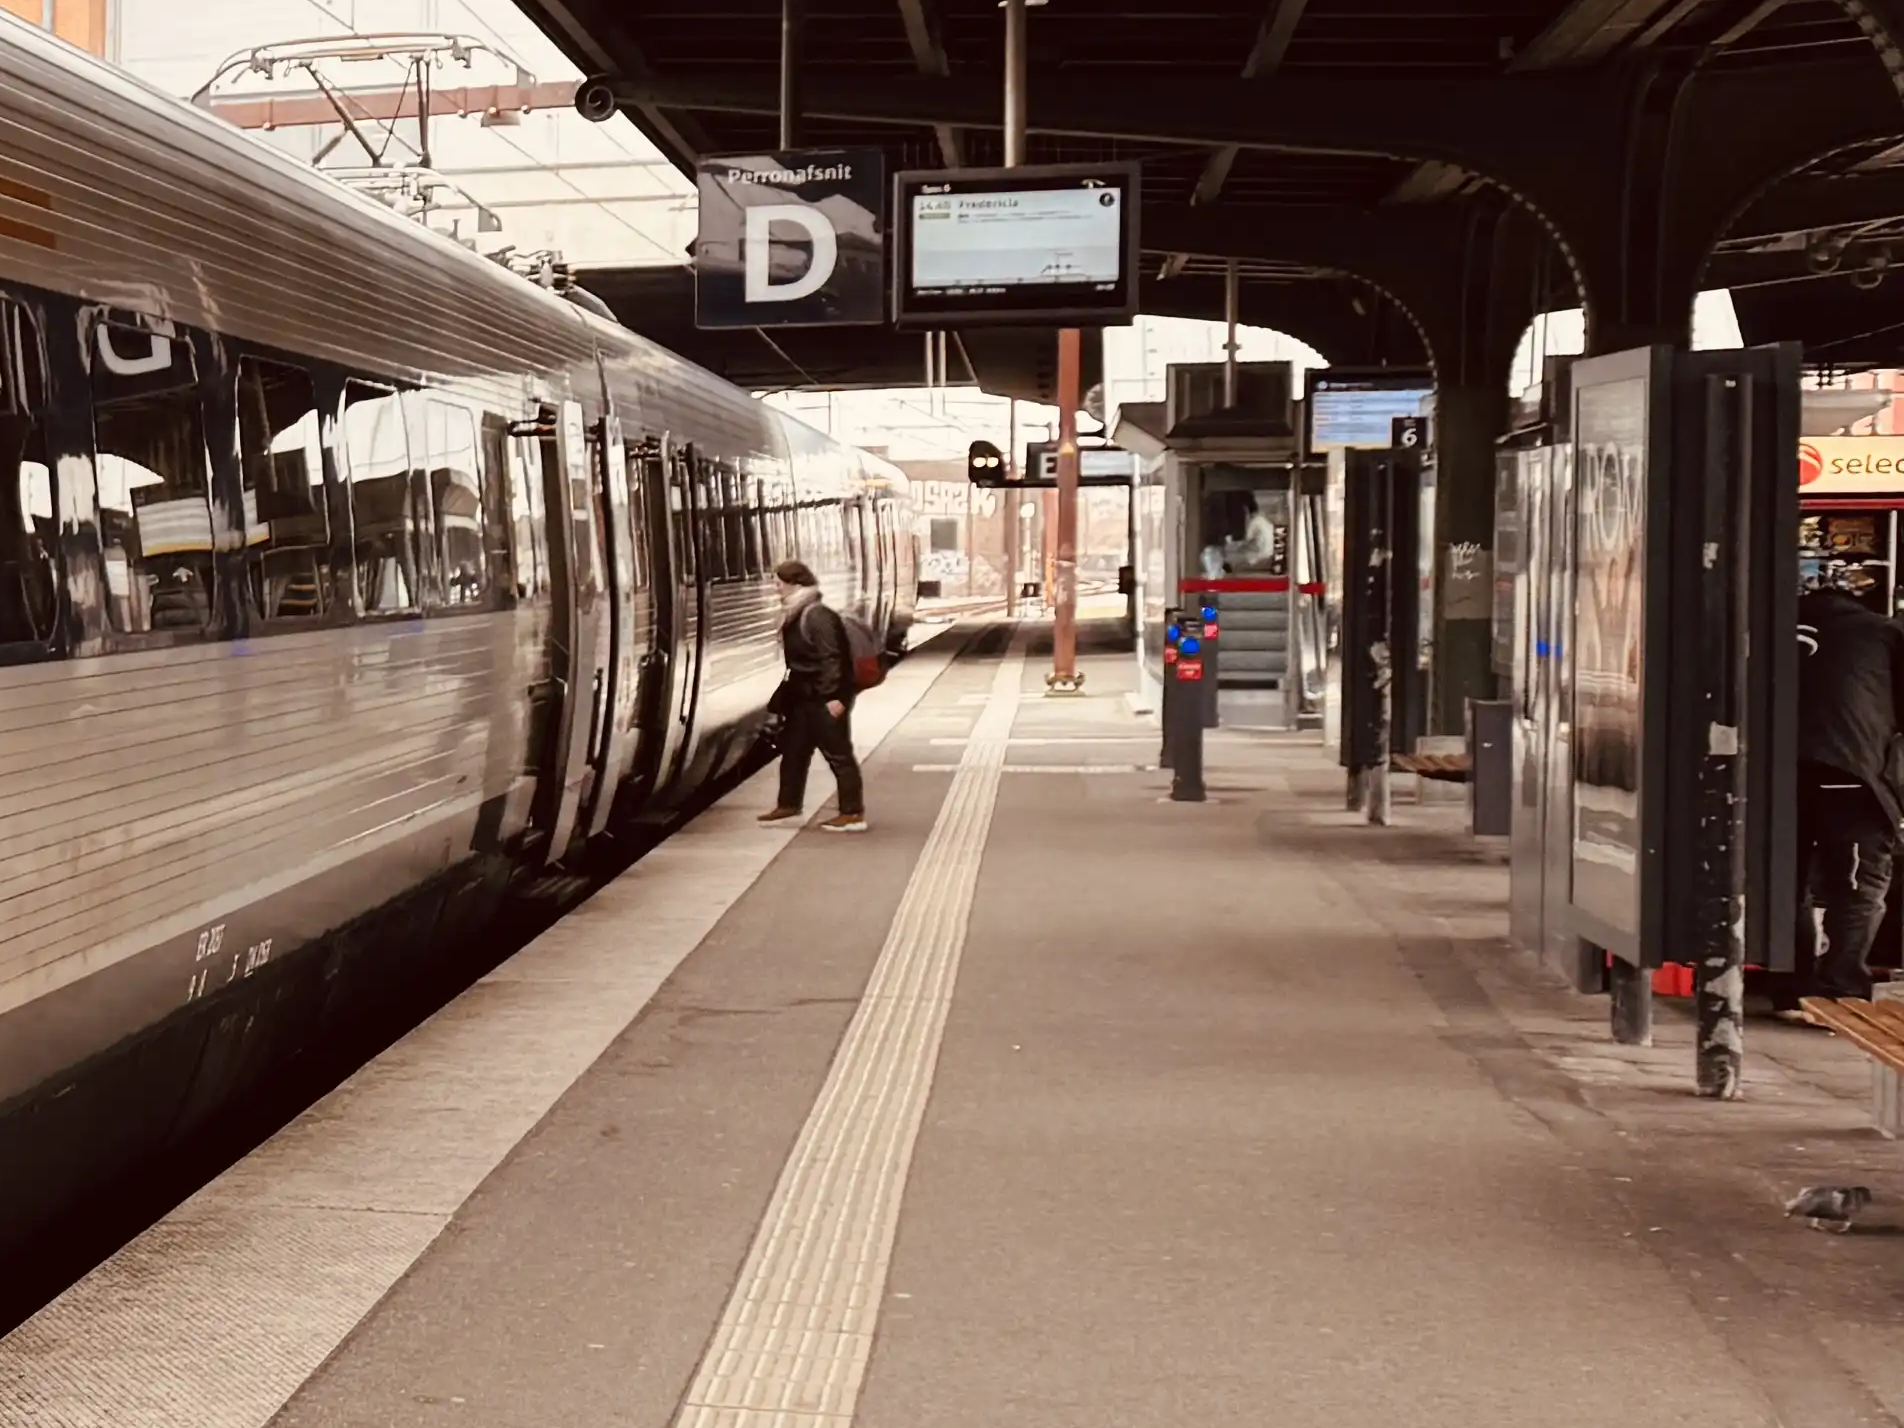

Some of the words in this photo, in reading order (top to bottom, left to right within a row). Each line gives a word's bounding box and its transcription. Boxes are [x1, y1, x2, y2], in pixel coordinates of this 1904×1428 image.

[728, 163, 852, 184] Perronafsnit
[745, 204, 838, 303] D
[1401, 427, 1418, 448] 6
